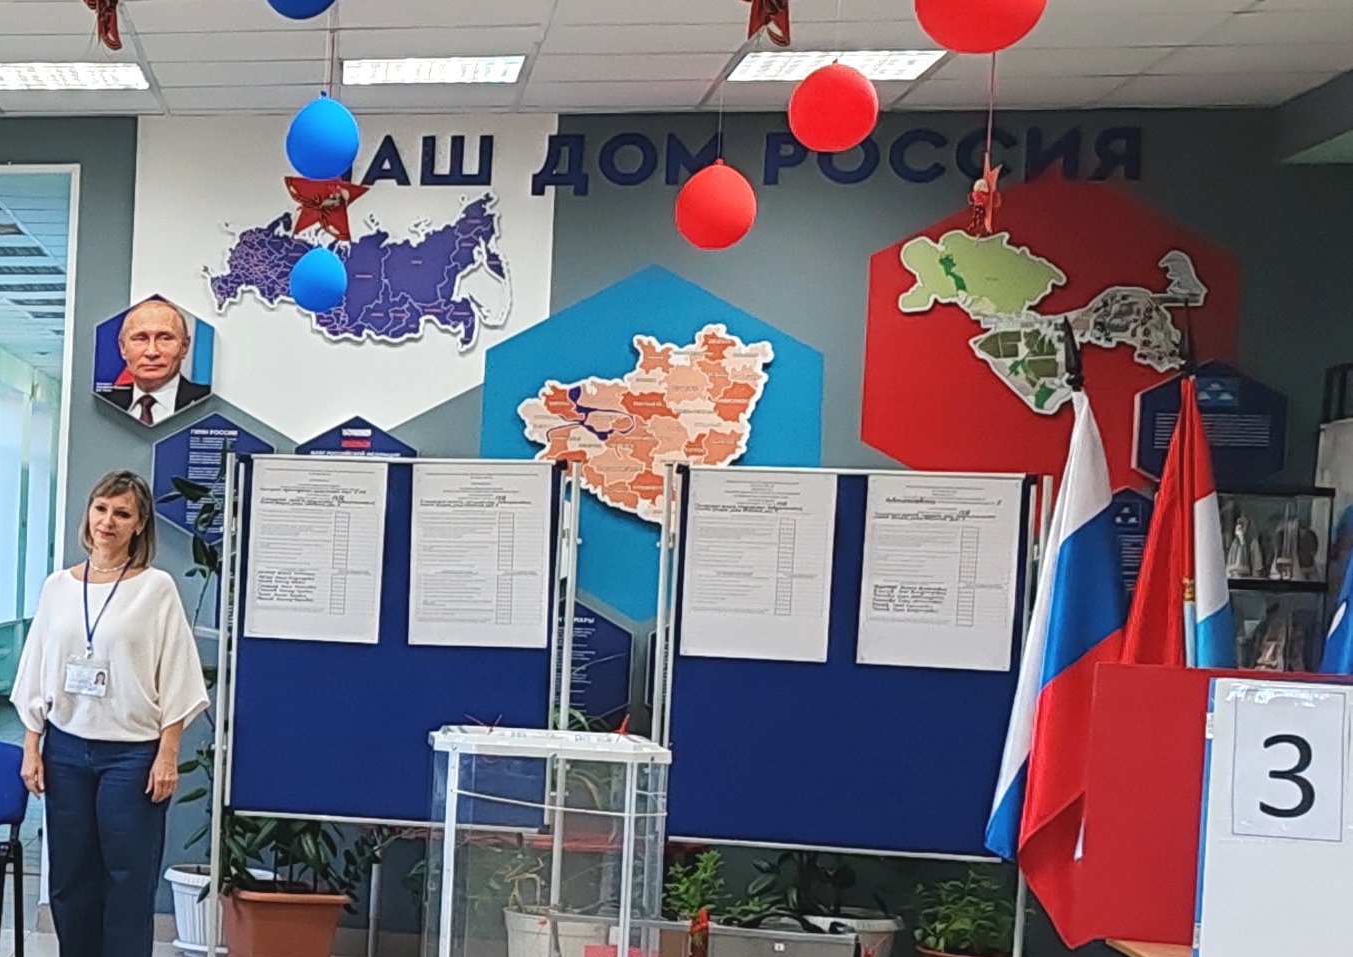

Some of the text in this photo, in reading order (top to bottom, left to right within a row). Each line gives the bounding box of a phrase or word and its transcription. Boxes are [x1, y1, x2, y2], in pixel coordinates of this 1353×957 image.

[342, 127, 1142, 195] АШ ДОМ РОССИЯ
[1259, 734, 1316, 818] 3
